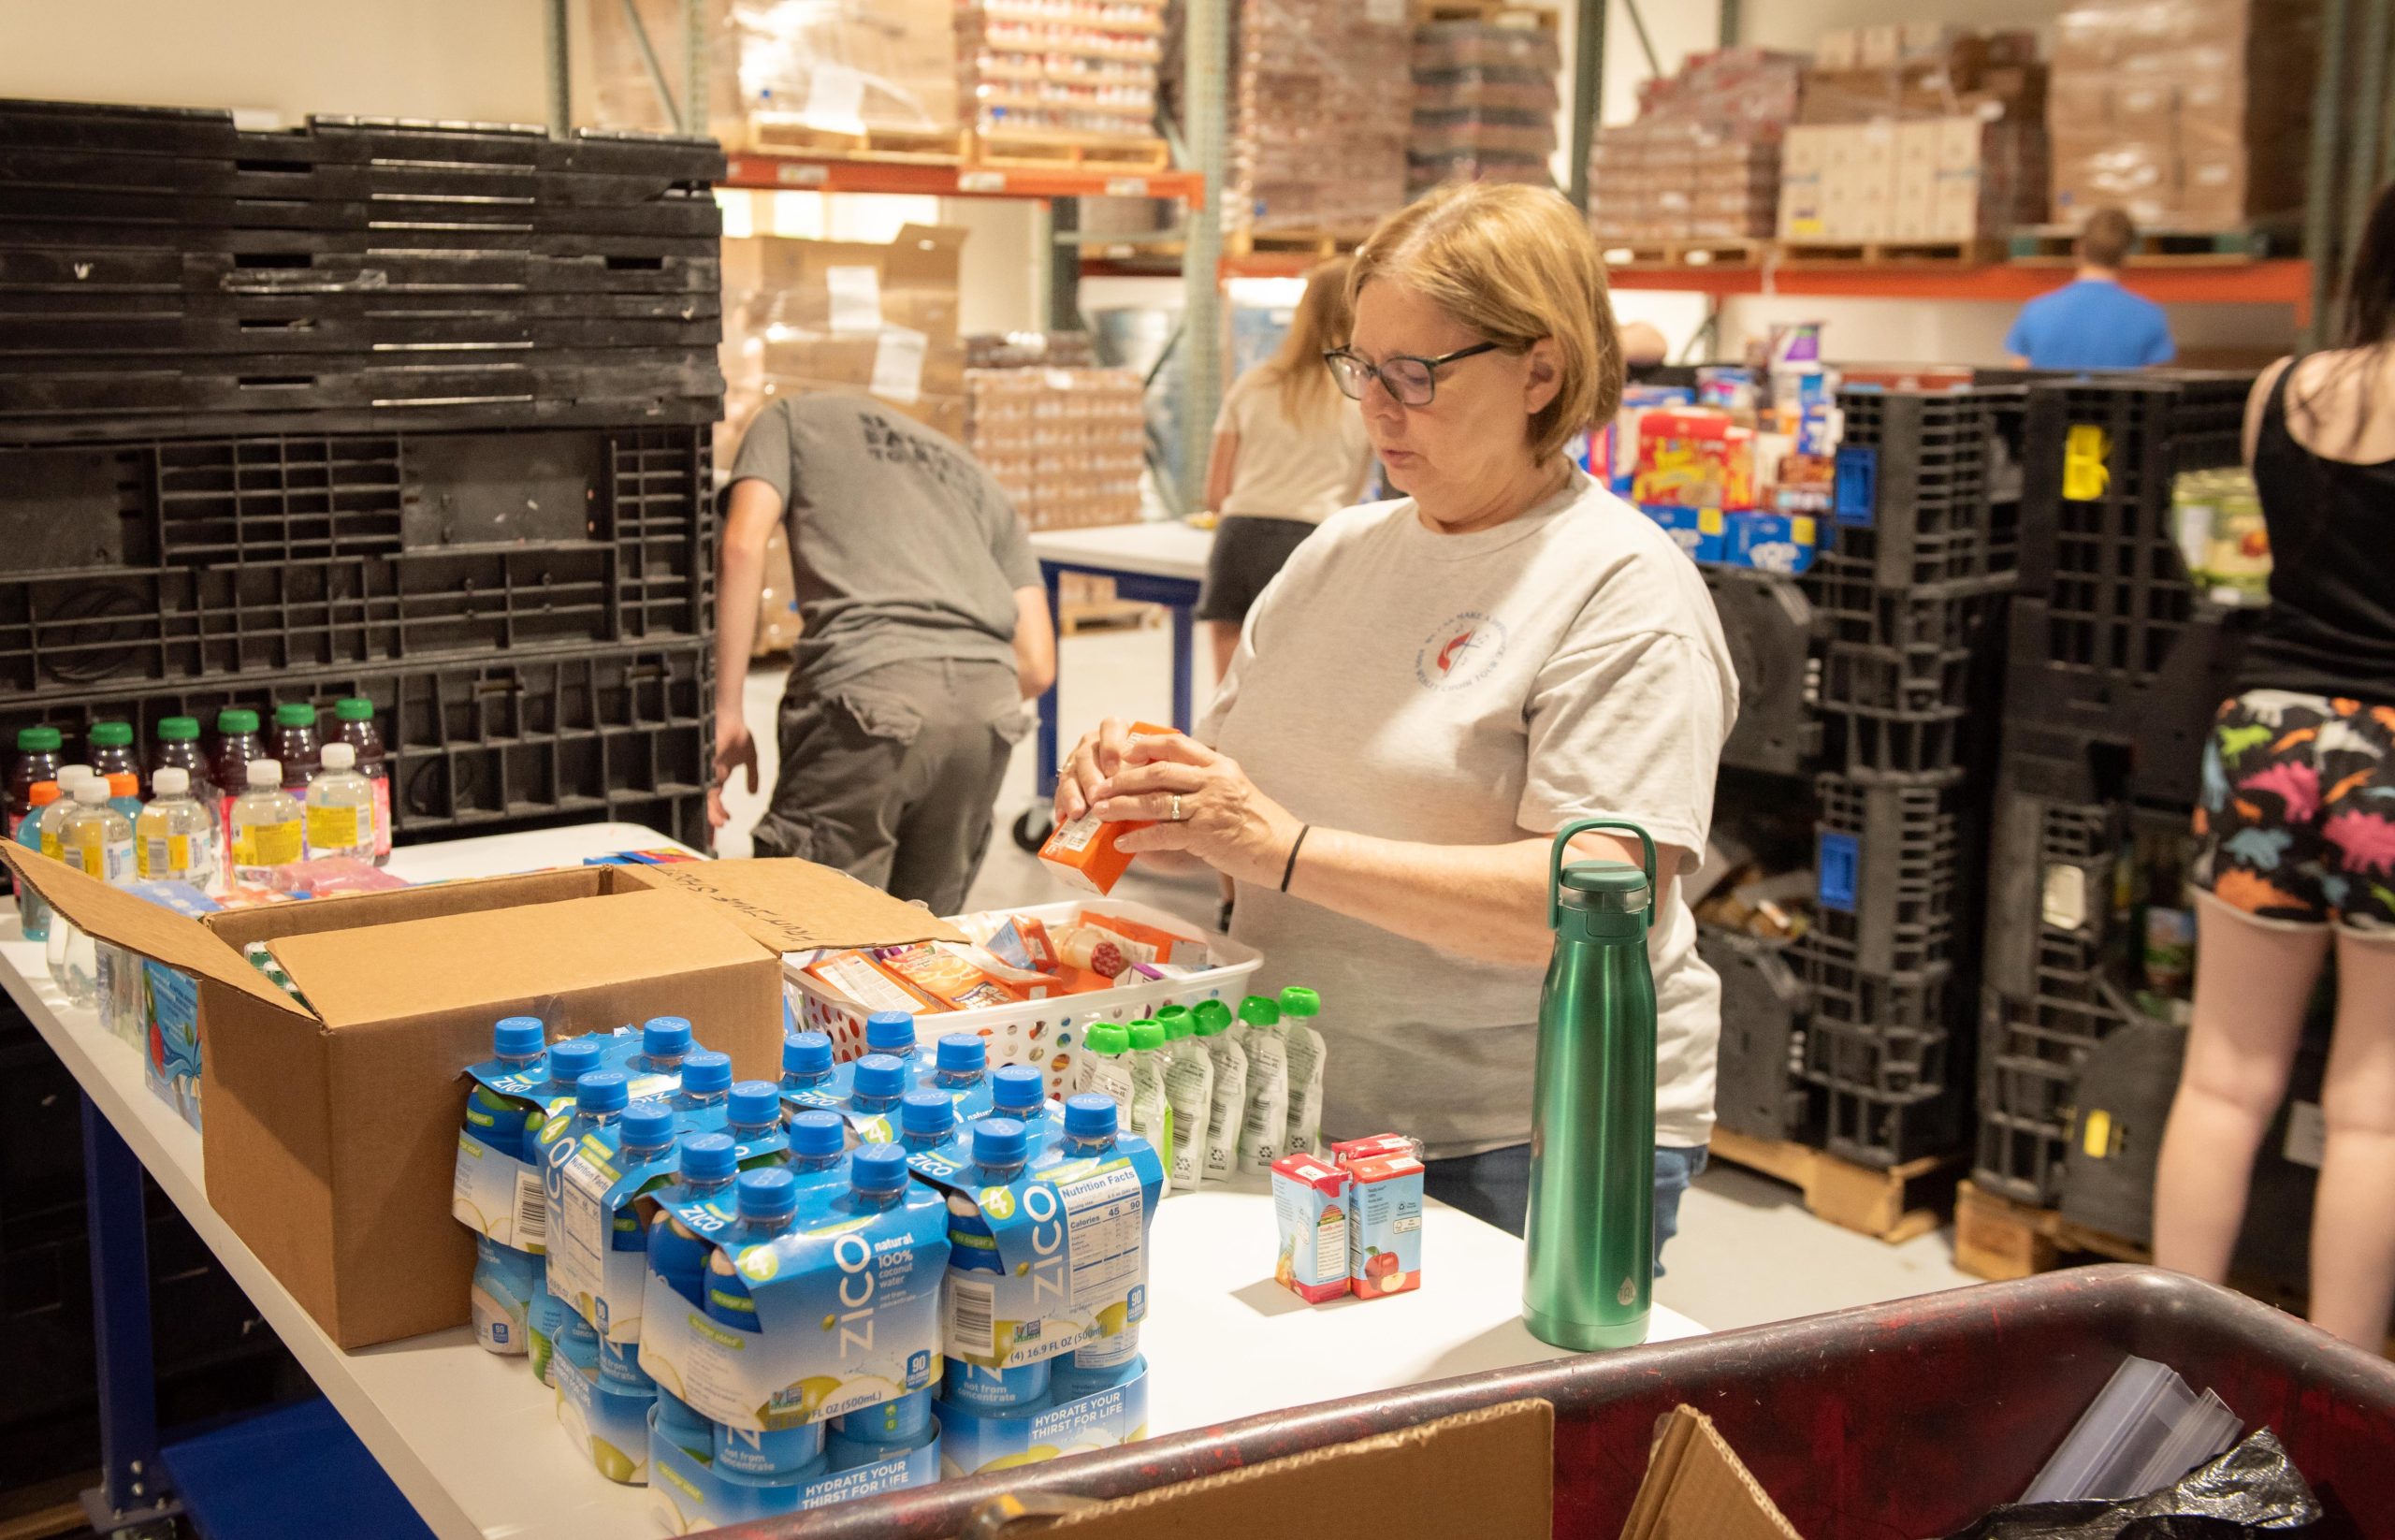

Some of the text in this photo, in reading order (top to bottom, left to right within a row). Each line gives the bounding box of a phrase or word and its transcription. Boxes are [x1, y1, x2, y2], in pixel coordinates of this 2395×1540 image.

[491, 1076, 532, 1094] ZICO
[581, 1072, 623, 1082] ZICO
[791, 1091, 838, 1108] ZICO
[1072, 1095, 1113, 1104] ZICO
[796, 1111, 839, 1122] ZICO
[966, 1107, 994, 1121] natur
[546, 1119, 567, 1140] 4
[868, 1116, 887, 1143] 4
[906, 1153, 953, 1177] ZICO
[1062, 1181, 1106, 1198] Nutrition
[1107, 1170, 1135, 1185] Facts
[989, 1190, 1008, 1215] 4
[678, 1204, 725, 1232] ZICO
[1070, 1199, 1140, 1229] Calories 45 90
[874, 1232, 914, 1253] natural
[1023, 1184, 1064, 1305] ZICO
[878, 1249, 913, 1269] 100%
[879, 1263, 913, 1279] coconut
[879, 1275, 906, 1288] water
[833, 1233, 875, 1358] ZICO
[1132, 1289, 1141, 1306] 90
[1010, 1351, 1024, 1363] (4)
[1027, 1344, 1047, 1358] 16.9
[1049, 1341, 1058, 1352] FL
[1061, 1336, 1072, 1347] OZ
[912, 1355, 925, 1373] 90
[957, 1388, 1017, 1402] concentrate
[963, 1382, 1008, 1394] not from
[812, 1408, 823, 1418] FL
[826, 1403, 839, 1415] OZ
[841, 1390, 882, 1411] (500mL)
[1035, 1392, 1121, 1428] HYDRATE YOUR
[1032, 1402, 1123, 1440] THIRST FOR LIFE
[719, 1453, 775, 1472] concentrate
[724, 1447, 765, 1463] not from
[806, 1460, 907, 1497] HYDRATE YOUR
[801, 1489, 849, 1510] THIRST
[851, 1480, 878, 1497] FOR
